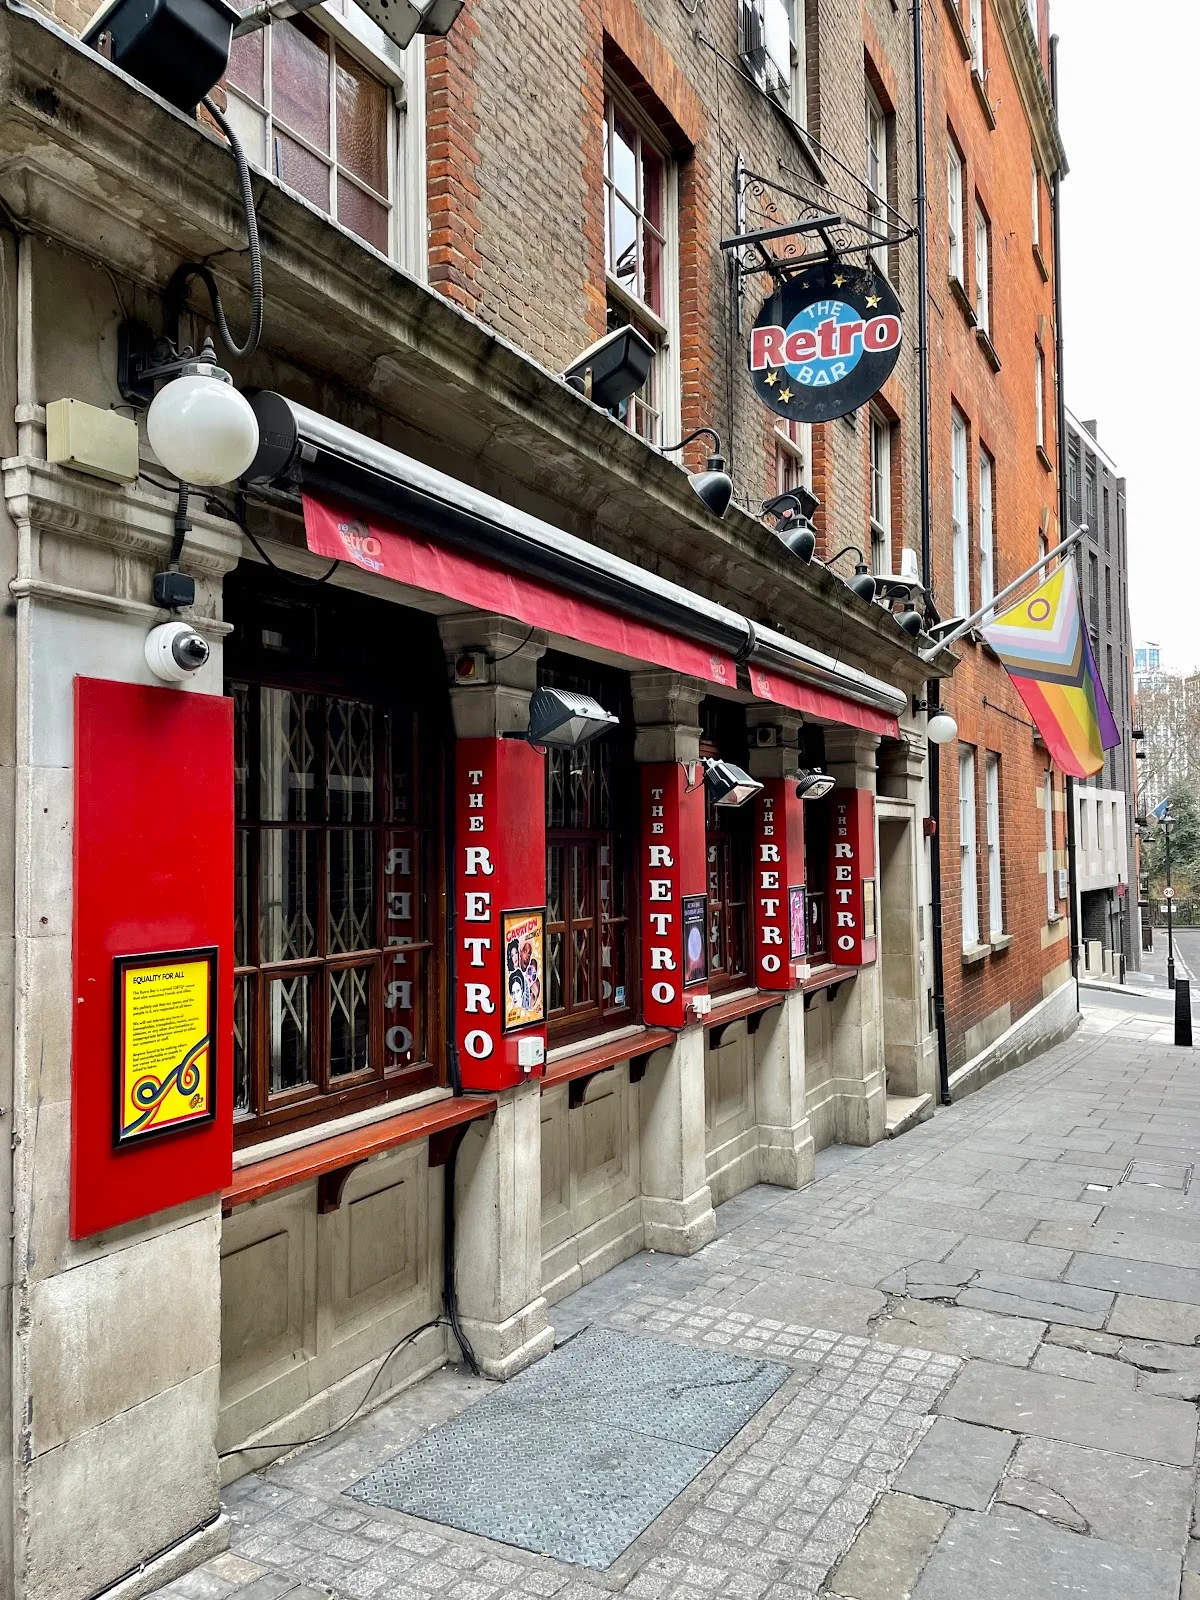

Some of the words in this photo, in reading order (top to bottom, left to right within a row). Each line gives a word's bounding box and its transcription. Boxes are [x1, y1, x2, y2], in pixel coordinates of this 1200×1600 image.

[804, 301, 844, 318] THE
[750, 315, 901, 371] Retro
[796, 361, 848, 386] BAR
[468, 770, 484, 831] THE
[652, 789, 664, 834] THE
[764, 798, 774, 836] THE
[838, 805, 848, 836] THE
[760, 844, 782, 972] RETRO
[834, 844, 856, 950] RETRO
[506, 923, 527, 942] CARRY
[528, 918, 538, 930] ON
[648, 846, 677, 1004] RETRO
[464, 847, 494, 1059] RETRO
[133, 974, 161, 984] EQUALITY
